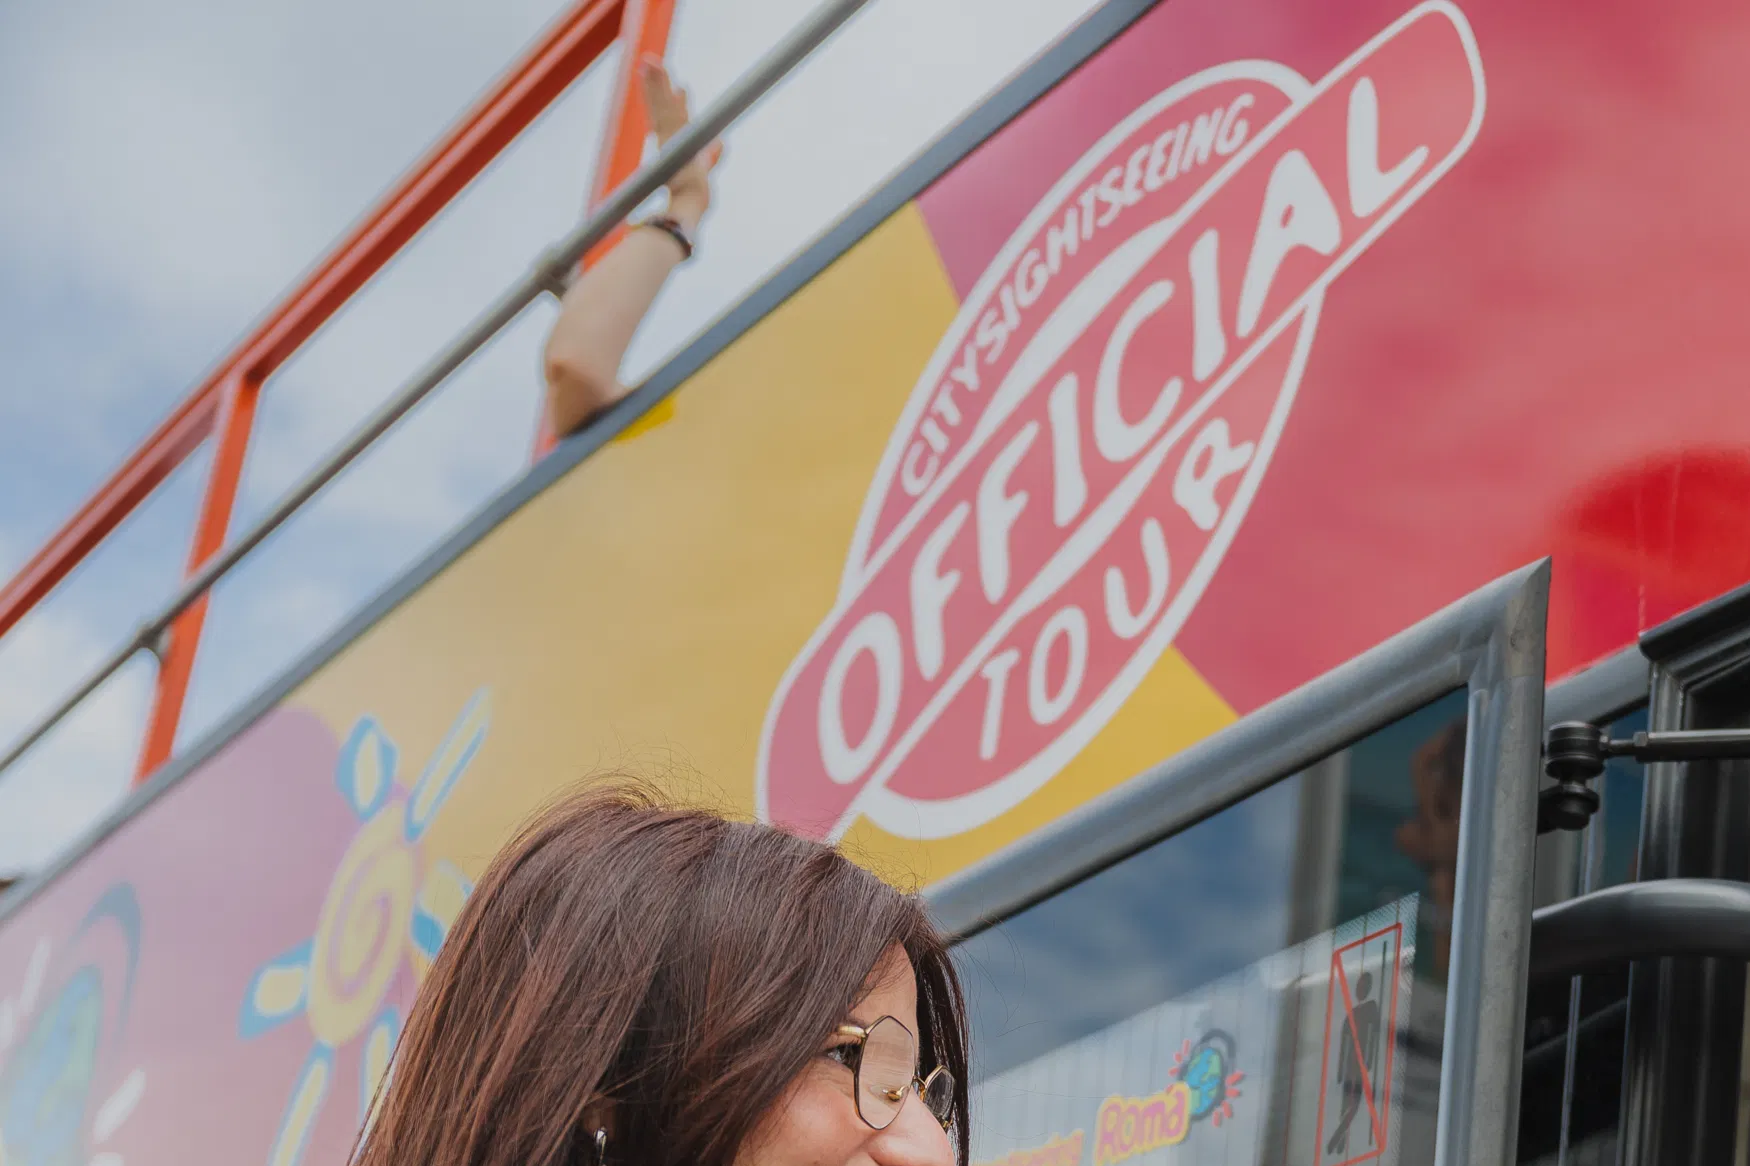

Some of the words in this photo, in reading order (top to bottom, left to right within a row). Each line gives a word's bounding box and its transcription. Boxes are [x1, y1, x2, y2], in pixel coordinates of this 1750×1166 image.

[817, 75, 1430, 785] OFFICIAL
[900, 93, 1254, 498] CITYSIGHTSEEING
[980, 417, 1256, 760] TOUR
